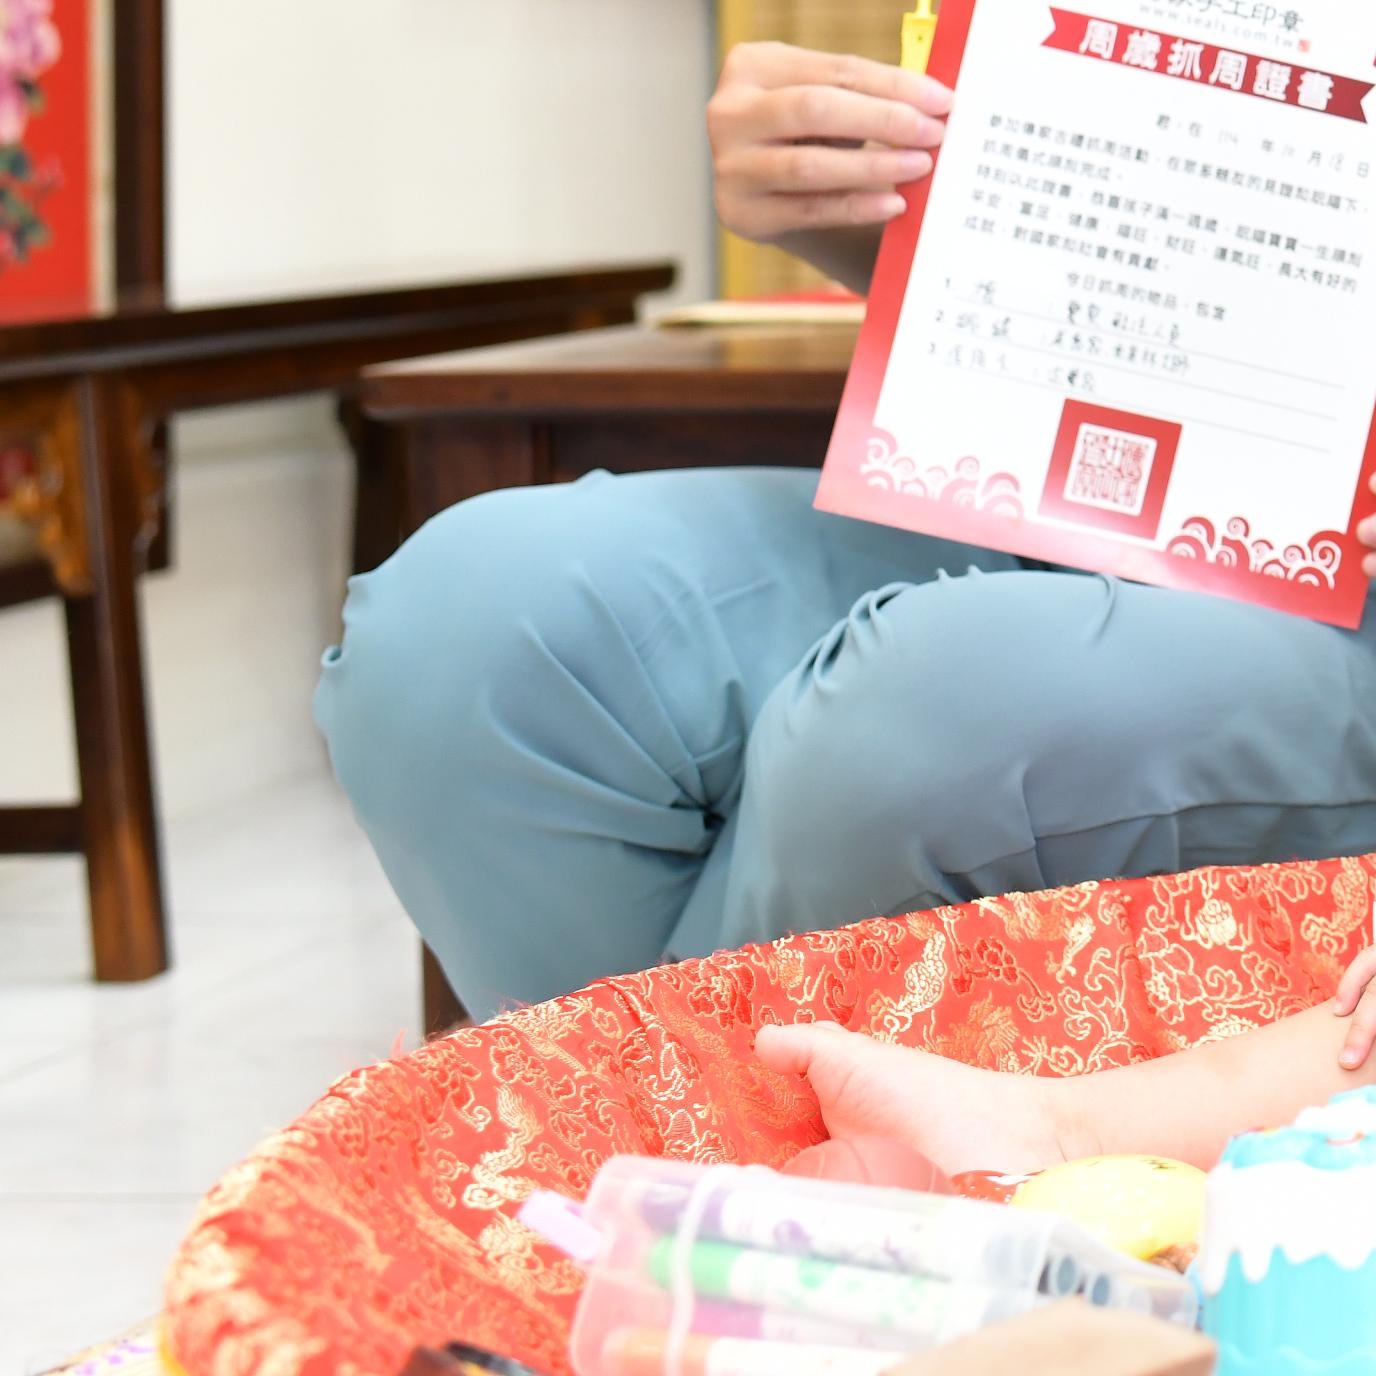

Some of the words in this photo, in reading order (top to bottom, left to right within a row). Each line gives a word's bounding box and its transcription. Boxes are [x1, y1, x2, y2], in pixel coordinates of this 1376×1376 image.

[1139, 4, 1295, 48] www.seals.com.tw
[1077, 17, 1336, 112] 周歲抓周證書
